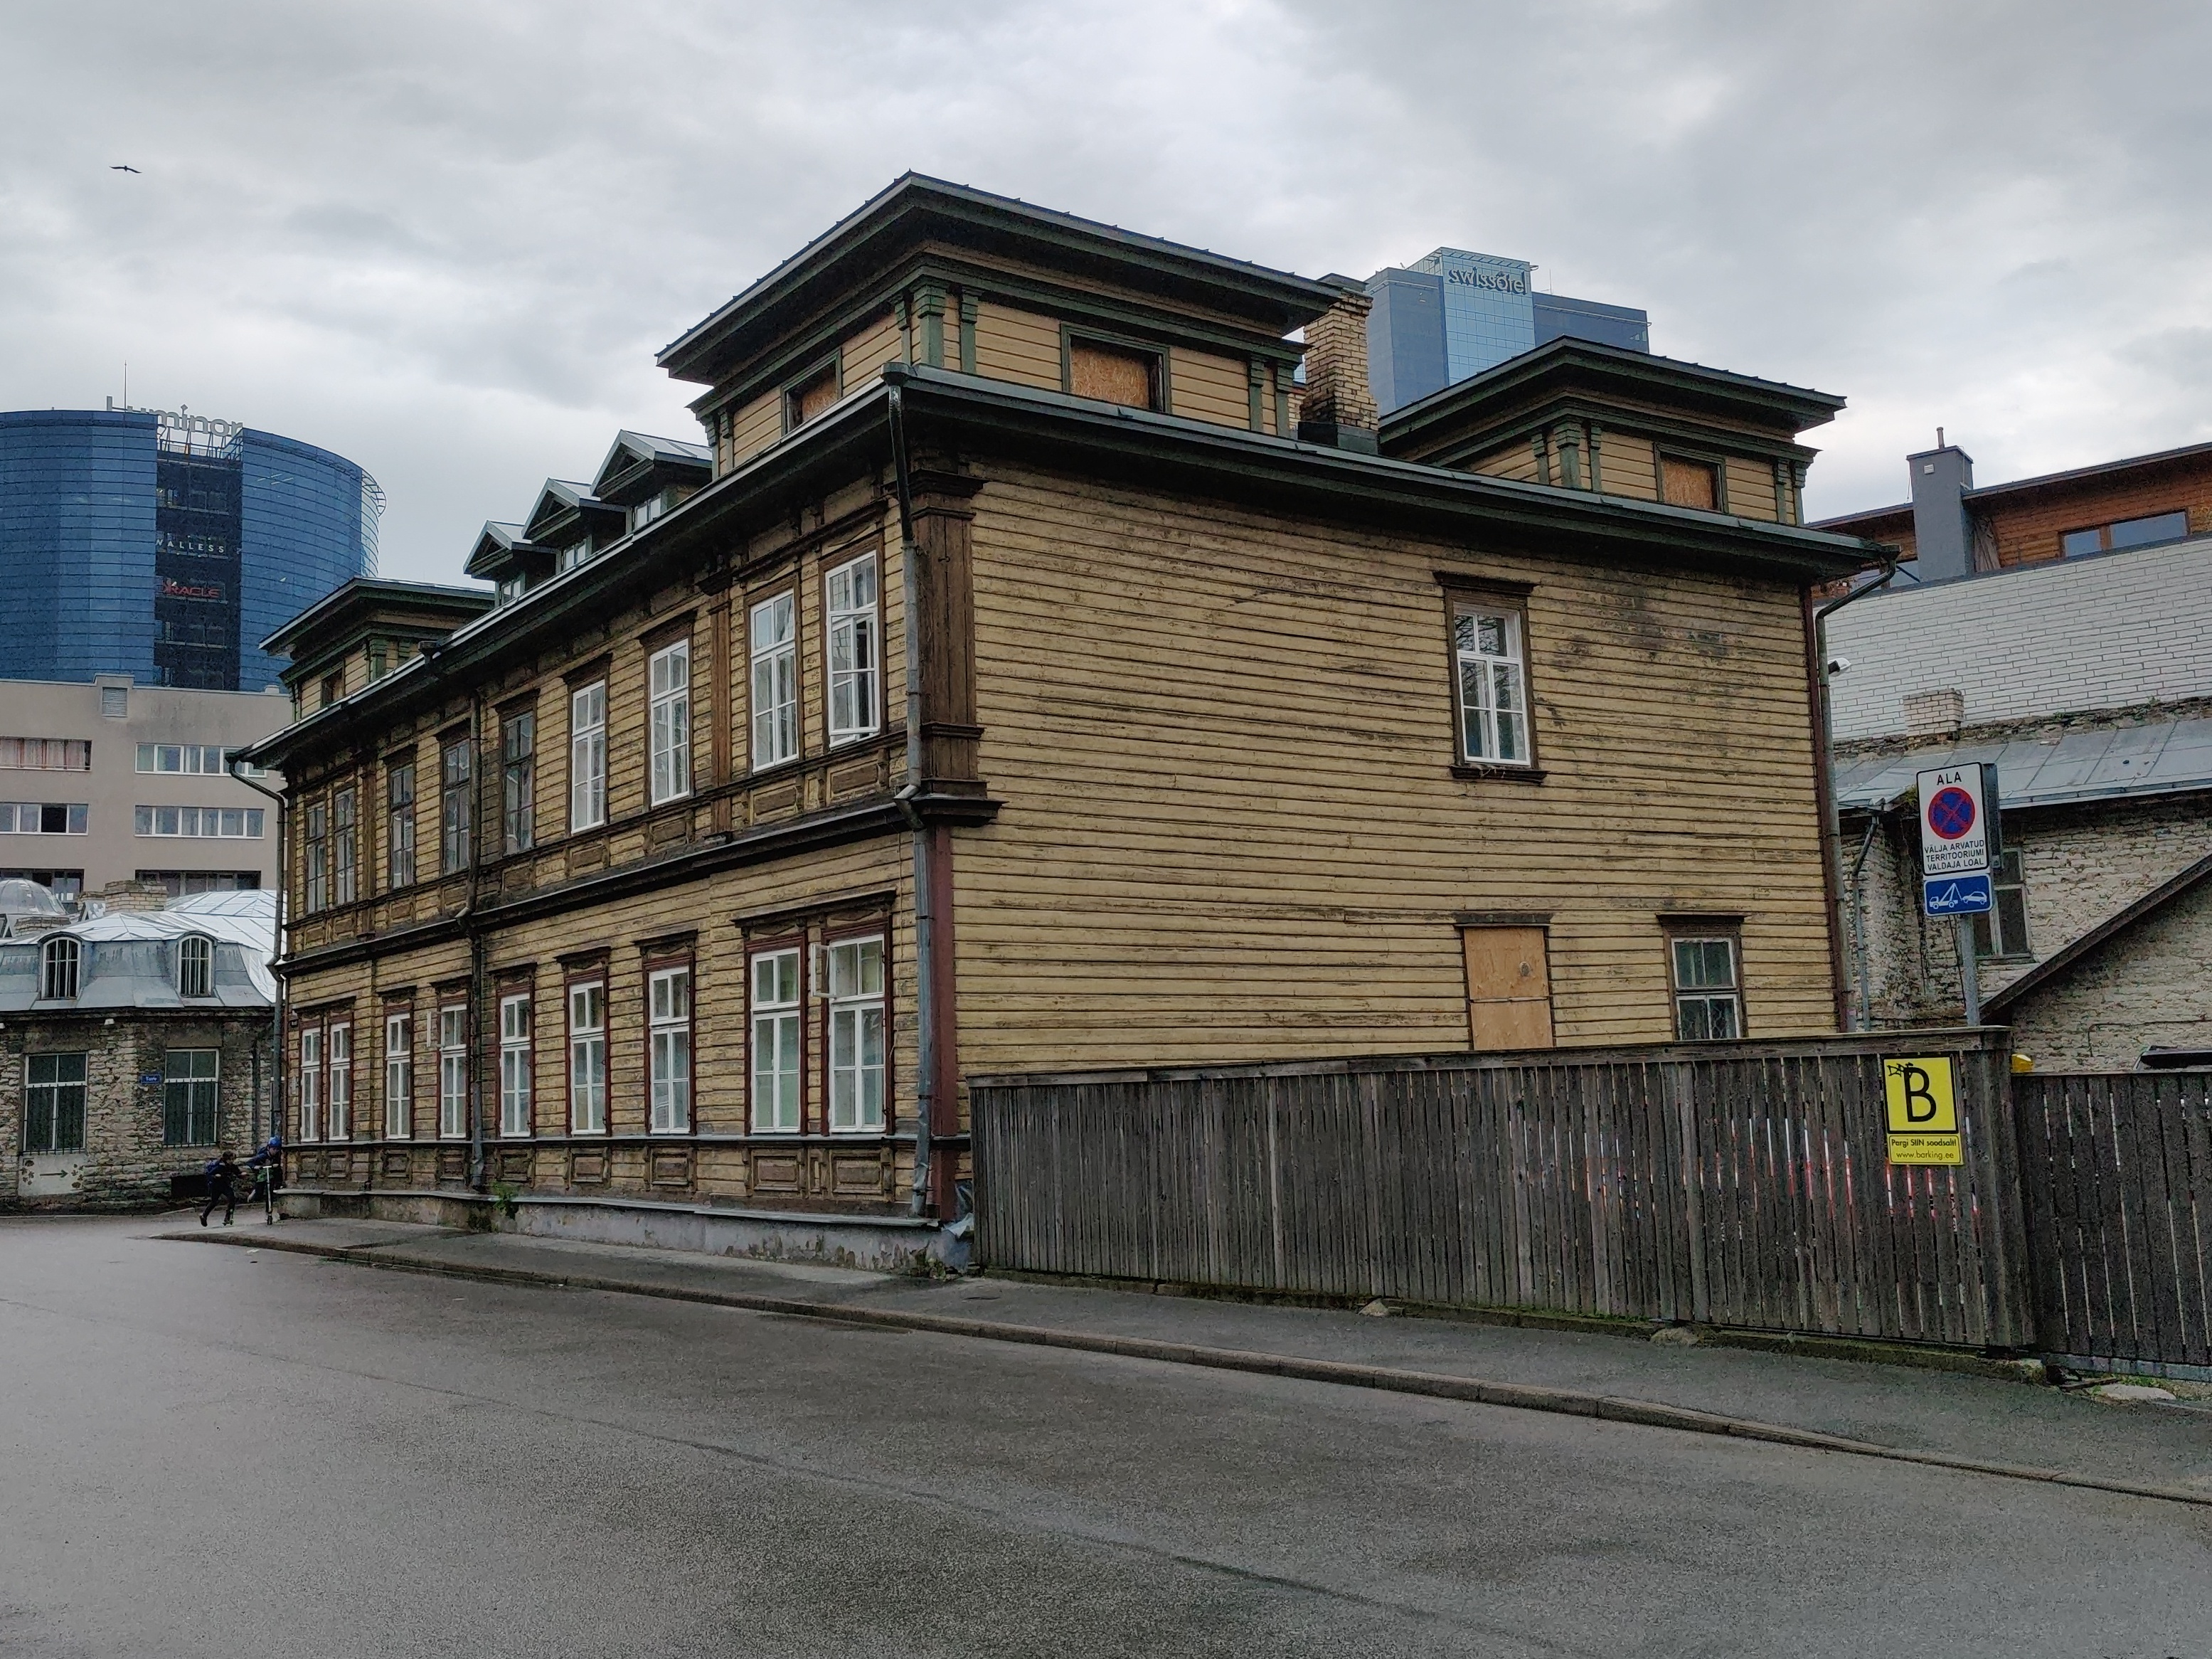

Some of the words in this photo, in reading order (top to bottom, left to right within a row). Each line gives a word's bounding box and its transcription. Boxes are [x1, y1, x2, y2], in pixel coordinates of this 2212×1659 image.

[1936, 771, 1962, 785] ALA
[1925, 844, 1948, 854] VÄLJA
[1950, 839, 1984, 851] ARVATUD
[1926, 849, 1984, 862] TERRITOORIUMI
[1927, 860, 1961, 871] VALDAJA
[1963, 858, 1984, 866] LOAL
[1903, 1066, 1937, 1122] B
[1891, 1139, 1909, 1148] Pargi
[1896, 1150, 1955, 1161] www.barking.ee
